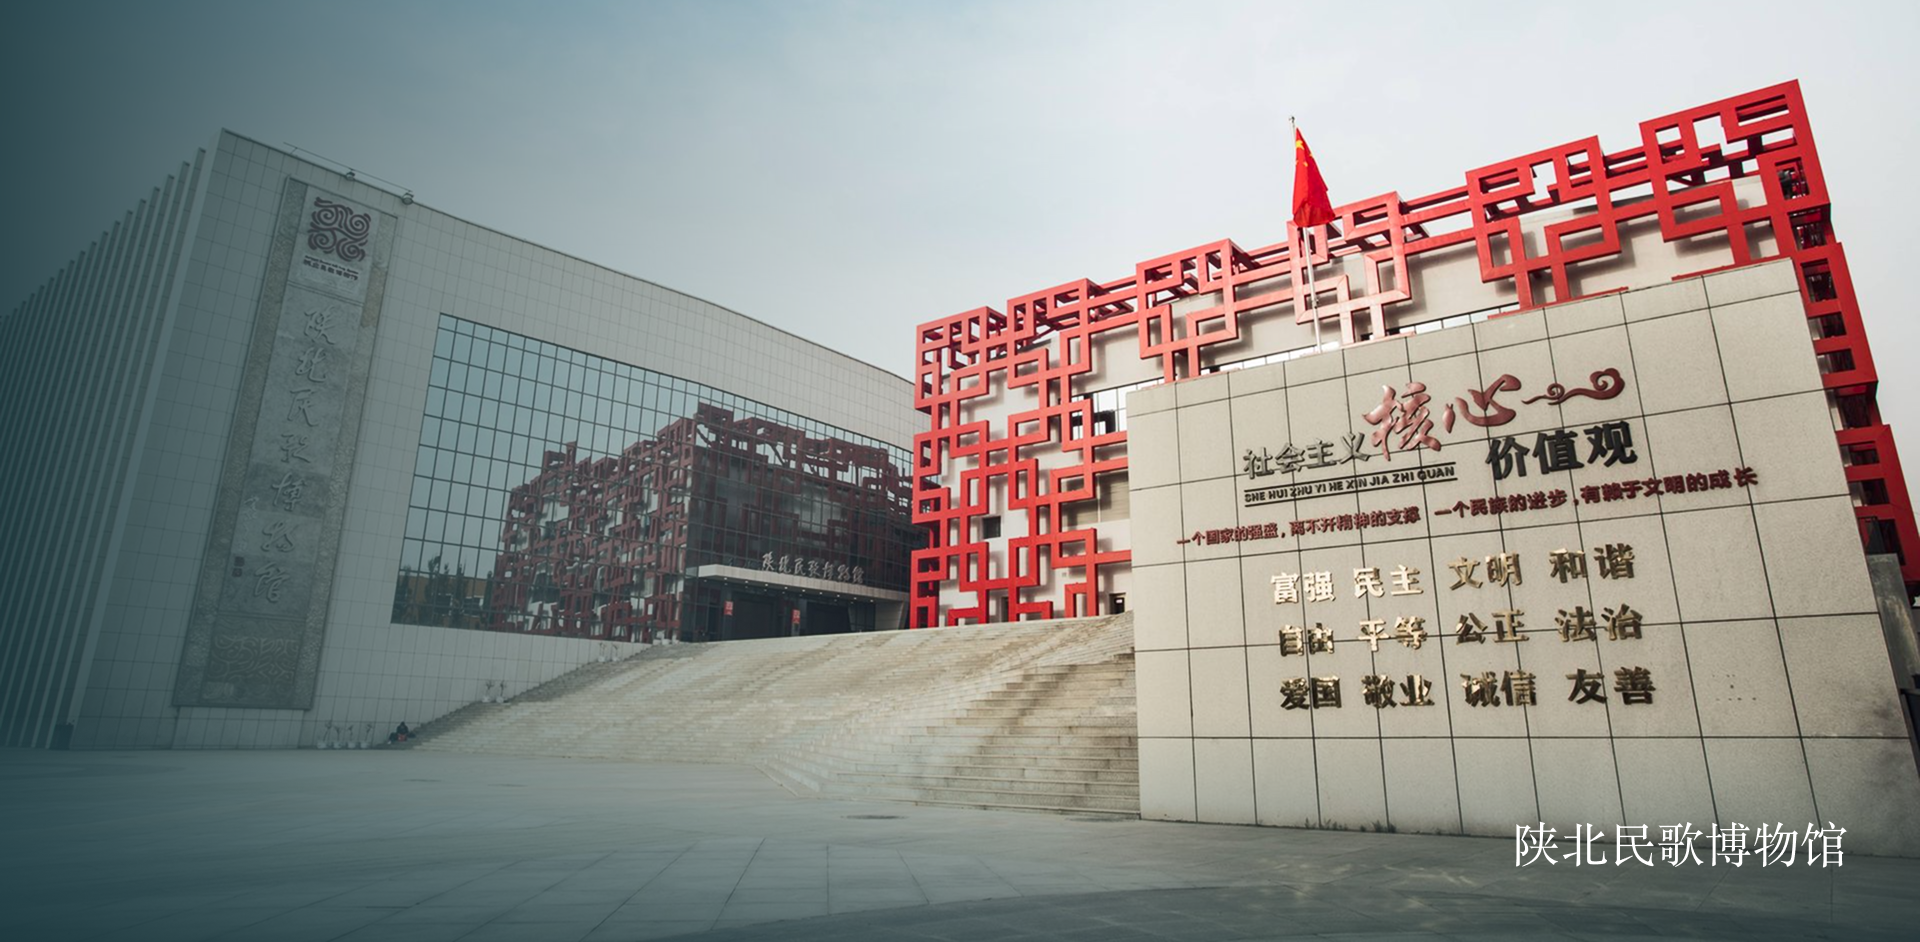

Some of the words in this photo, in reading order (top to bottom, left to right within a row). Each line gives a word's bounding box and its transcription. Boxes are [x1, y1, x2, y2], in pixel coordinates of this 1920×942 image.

[1243, 431, 1371, 479] 社会主义
[1362, 373, 1522, 461] 核心
[1484, 421, 1639, 481] 价值观
[1244, 491, 1266, 503] SHE
[1268, 488, 1288, 501] HUI
[1289, 485, 1313, 498] ZHU
[1316, 483, 1327, 494] YI
[1329, 480, 1344, 493] HE
[1345, 476, 1368, 491] XIN
[1369, 474, 1390, 487] JIA
[1392, 470, 1415, 485] ZHI
[1417, 466, 1456, 481] GUAN
[1270, 570, 1336, 604] 富强
[1353, 564, 1424, 598] 民主
[1448, 552, 1522, 590] 文明
[1549, 543, 1635, 583] 和谐
[1278, 622, 1335, 656] 自由
[1358, 616, 1428, 652] 平等
[1455, 609, 1530, 645] 公正
[1554, 603, 1642, 642] 法治
[1279, 674, 1342, 711] 爱国
[1360, 674, 1435, 709] 敬业
[1460, 669, 1538, 707] 诚信
[1566, 665, 1656, 706] 友善
